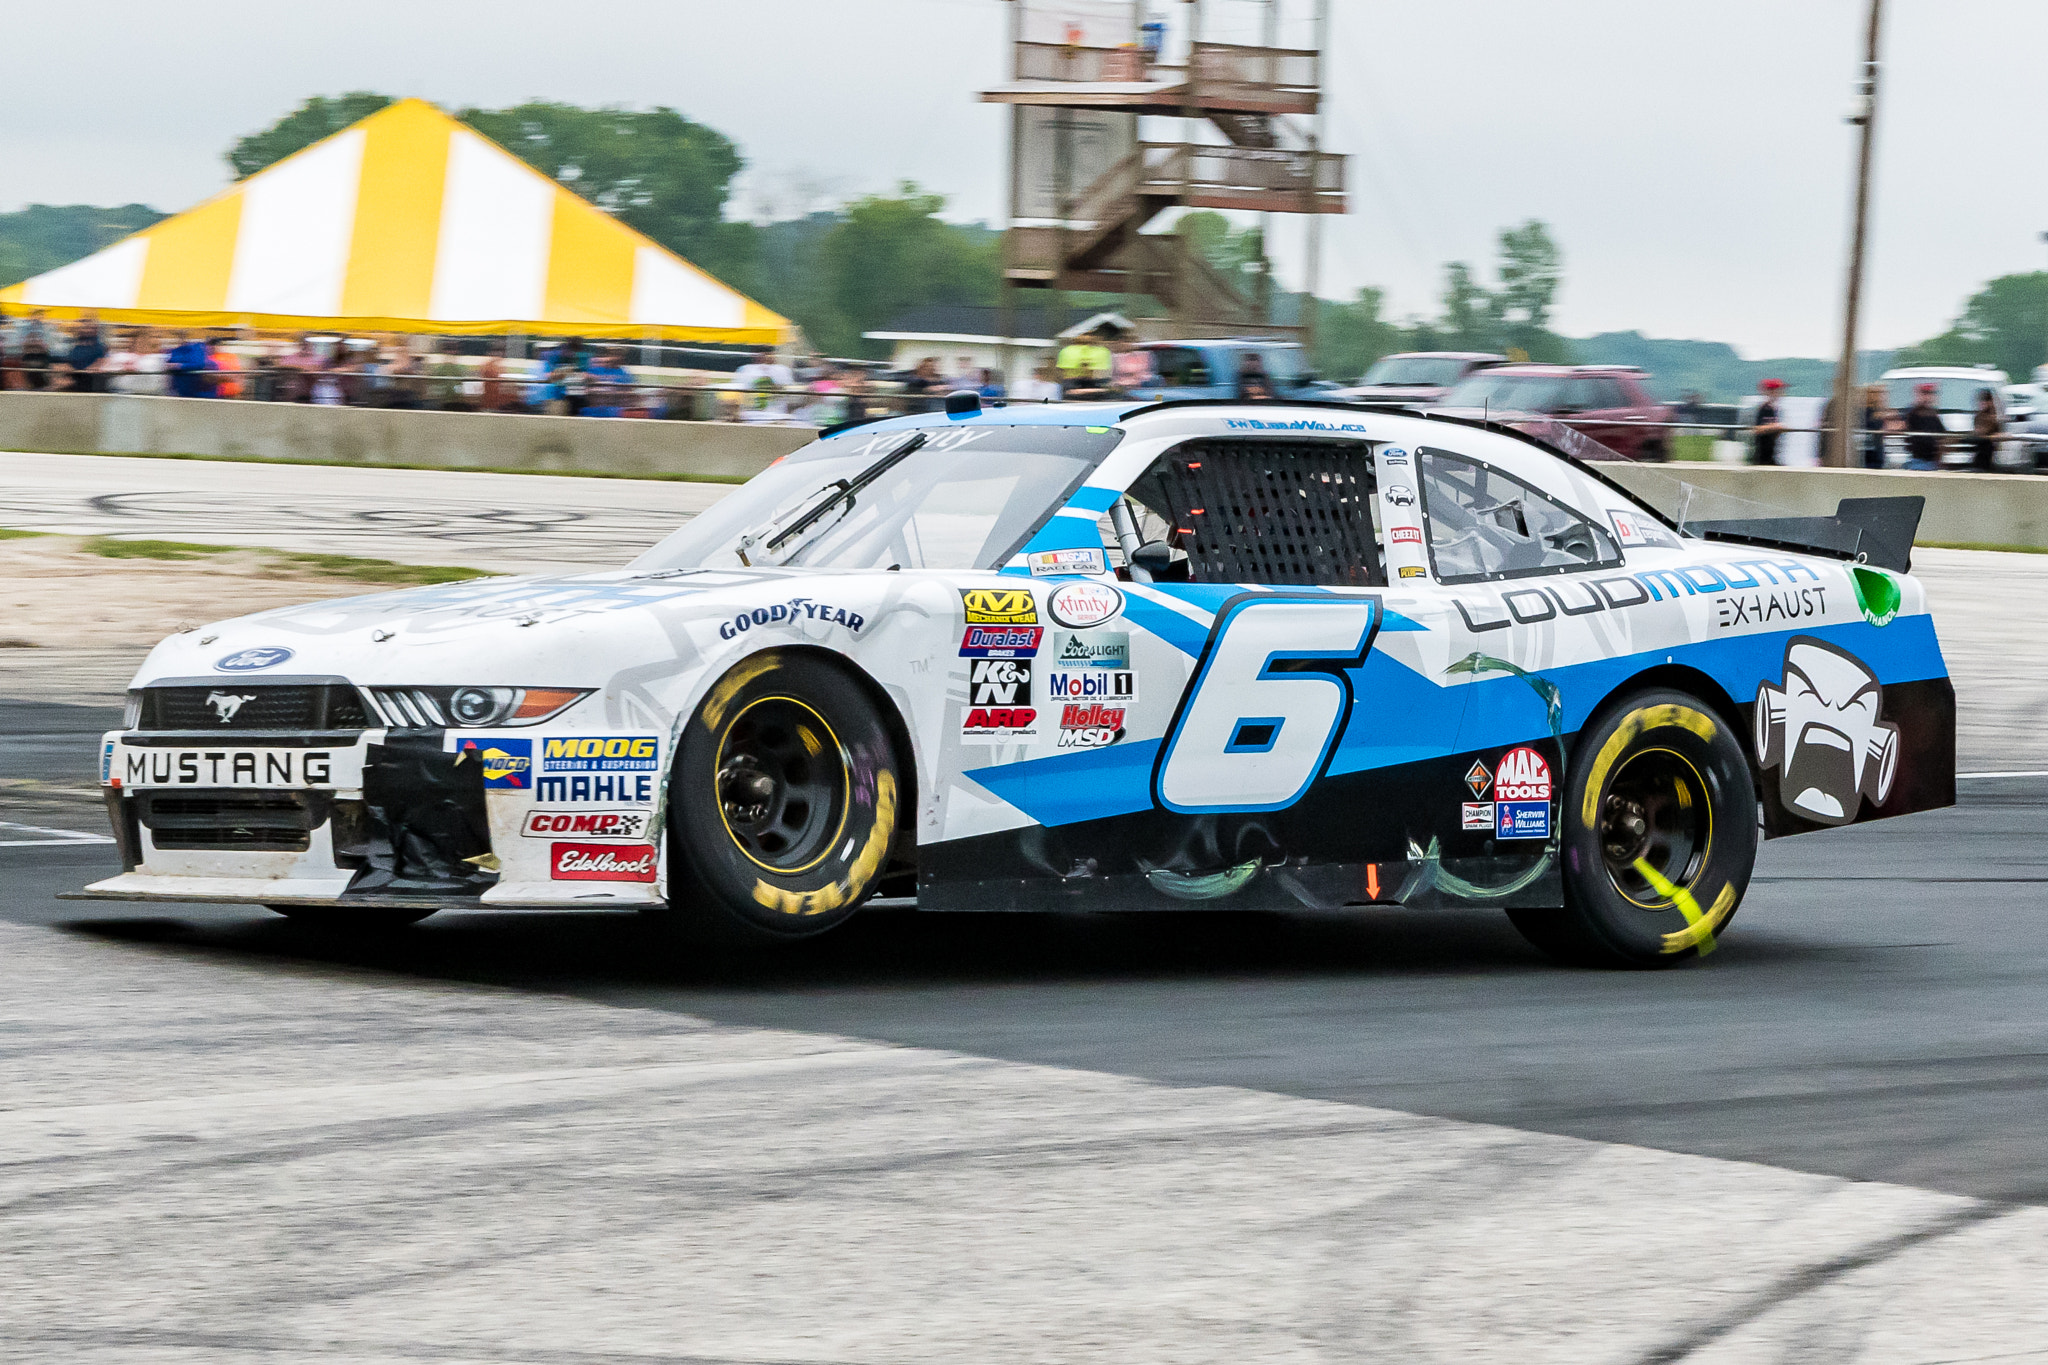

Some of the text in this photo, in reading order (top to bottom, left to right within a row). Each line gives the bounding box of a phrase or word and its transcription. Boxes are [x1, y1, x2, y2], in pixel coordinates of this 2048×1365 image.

[1056, 551, 1092, 562] NASCAR
[1057, 595, 1108, 615] xfinity
[1716, 587, 1827, 628] EXHAUST
[720, 602, 864, 640] GOODYEAR
[1012, 612, 1037, 622] WEAR
[1864, 608, 1897, 627] ETHANOL
[969, 629, 1035, 647] Duralast
[1065, 640, 1125, 657] Coors LIGHT
[1050, 673, 1107, 695] Mobil
[1153, 594, 1381, 813] 6
[963, 708, 1037, 728] ARP
[1060, 704, 1126, 731] Holley
[1058, 728, 1116, 747] MSD
[544, 739, 657, 758] MOOG
[127, 752, 331, 784] MUSTANG
[544, 760, 588, 770] STEERING
[601, 760, 657, 770] SUSPENSION
[1496, 750, 1550, 785] MAC
[536, 775, 652, 802] MAHLE
[1496, 785, 1550, 799] TOOLS
[1465, 809, 1492, 817] CHAMPION
[1516, 810, 1546, 819] SHERWIN
[530, 815, 620, 832] COMP
[558, 850, 651, 873] Edelbrock
